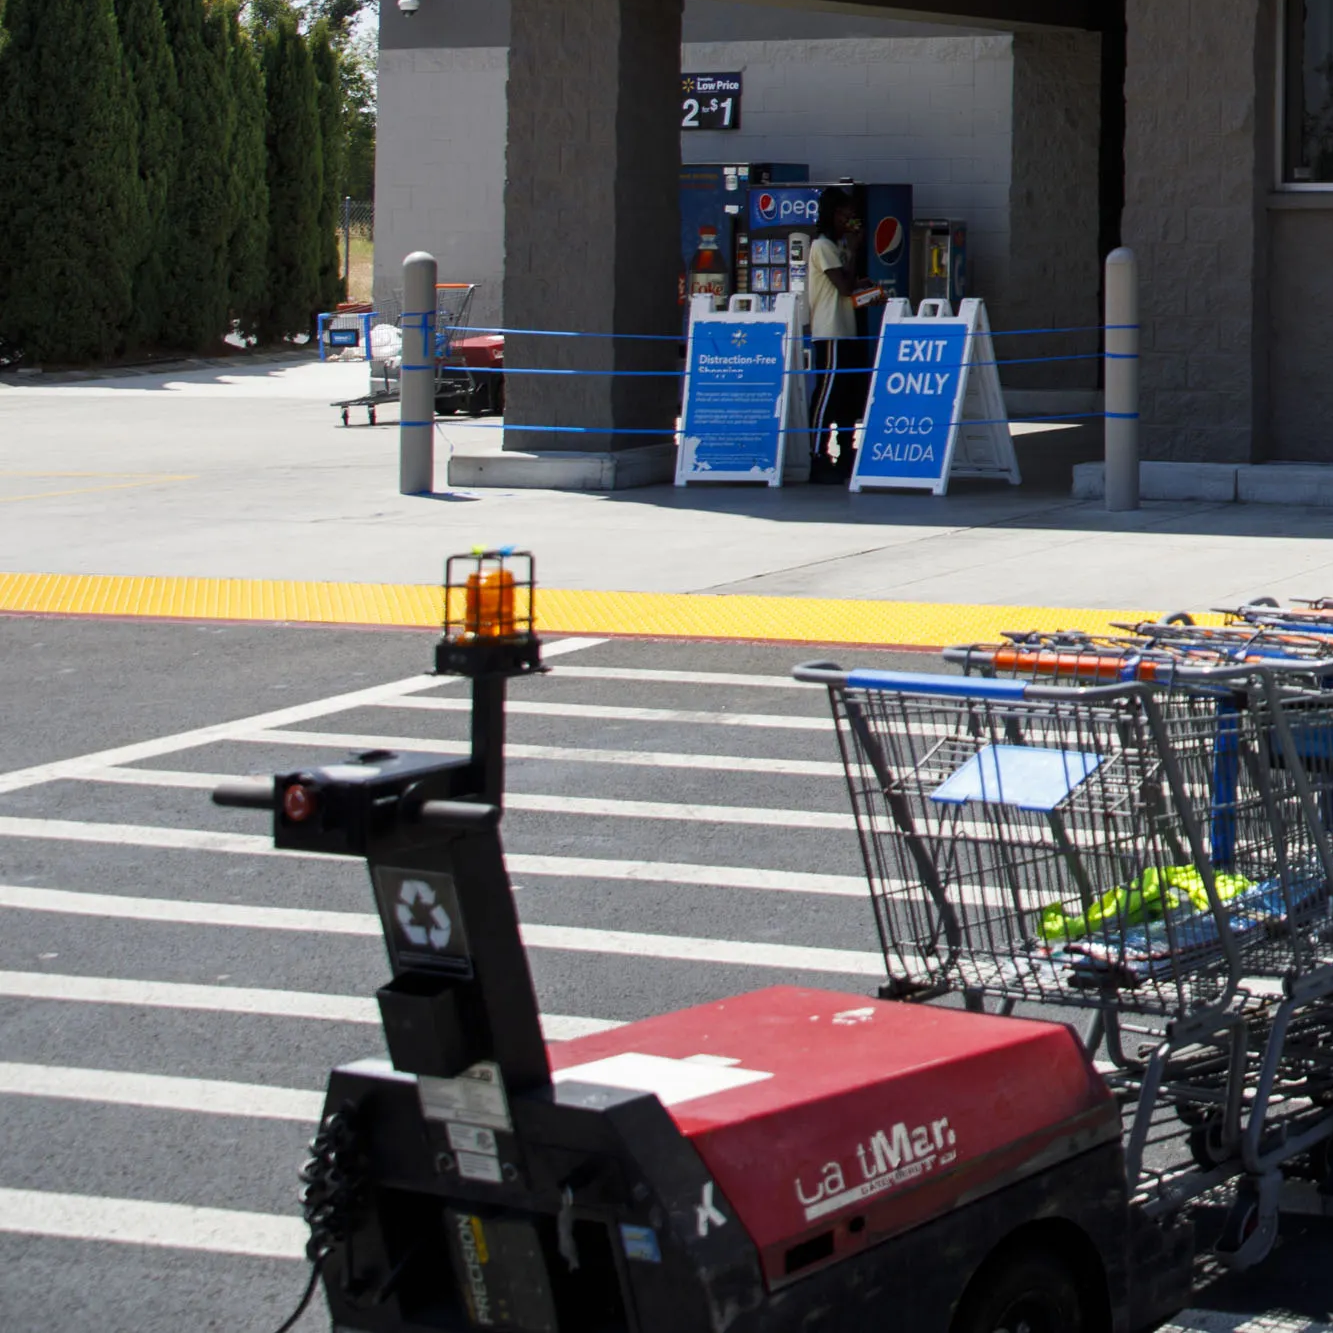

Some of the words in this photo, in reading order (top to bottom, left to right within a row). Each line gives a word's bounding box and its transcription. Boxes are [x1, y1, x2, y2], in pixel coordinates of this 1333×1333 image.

[697, 81, 716, 90] Low
[717, 80, 739, 90] Price
[682, 98, 700, 126] 2
[780, 199, 819, 219] pep
[698, 354, 777, 365] Distraction-Free
[898, 340, 948, 362] EXIT
[886, 372, 950, 395] ONLY
[884, 416, 934, 435] SOLO
[872, 442, 935, 462] SALIDA
[455, 1213, 495, 1326] PRECISION
